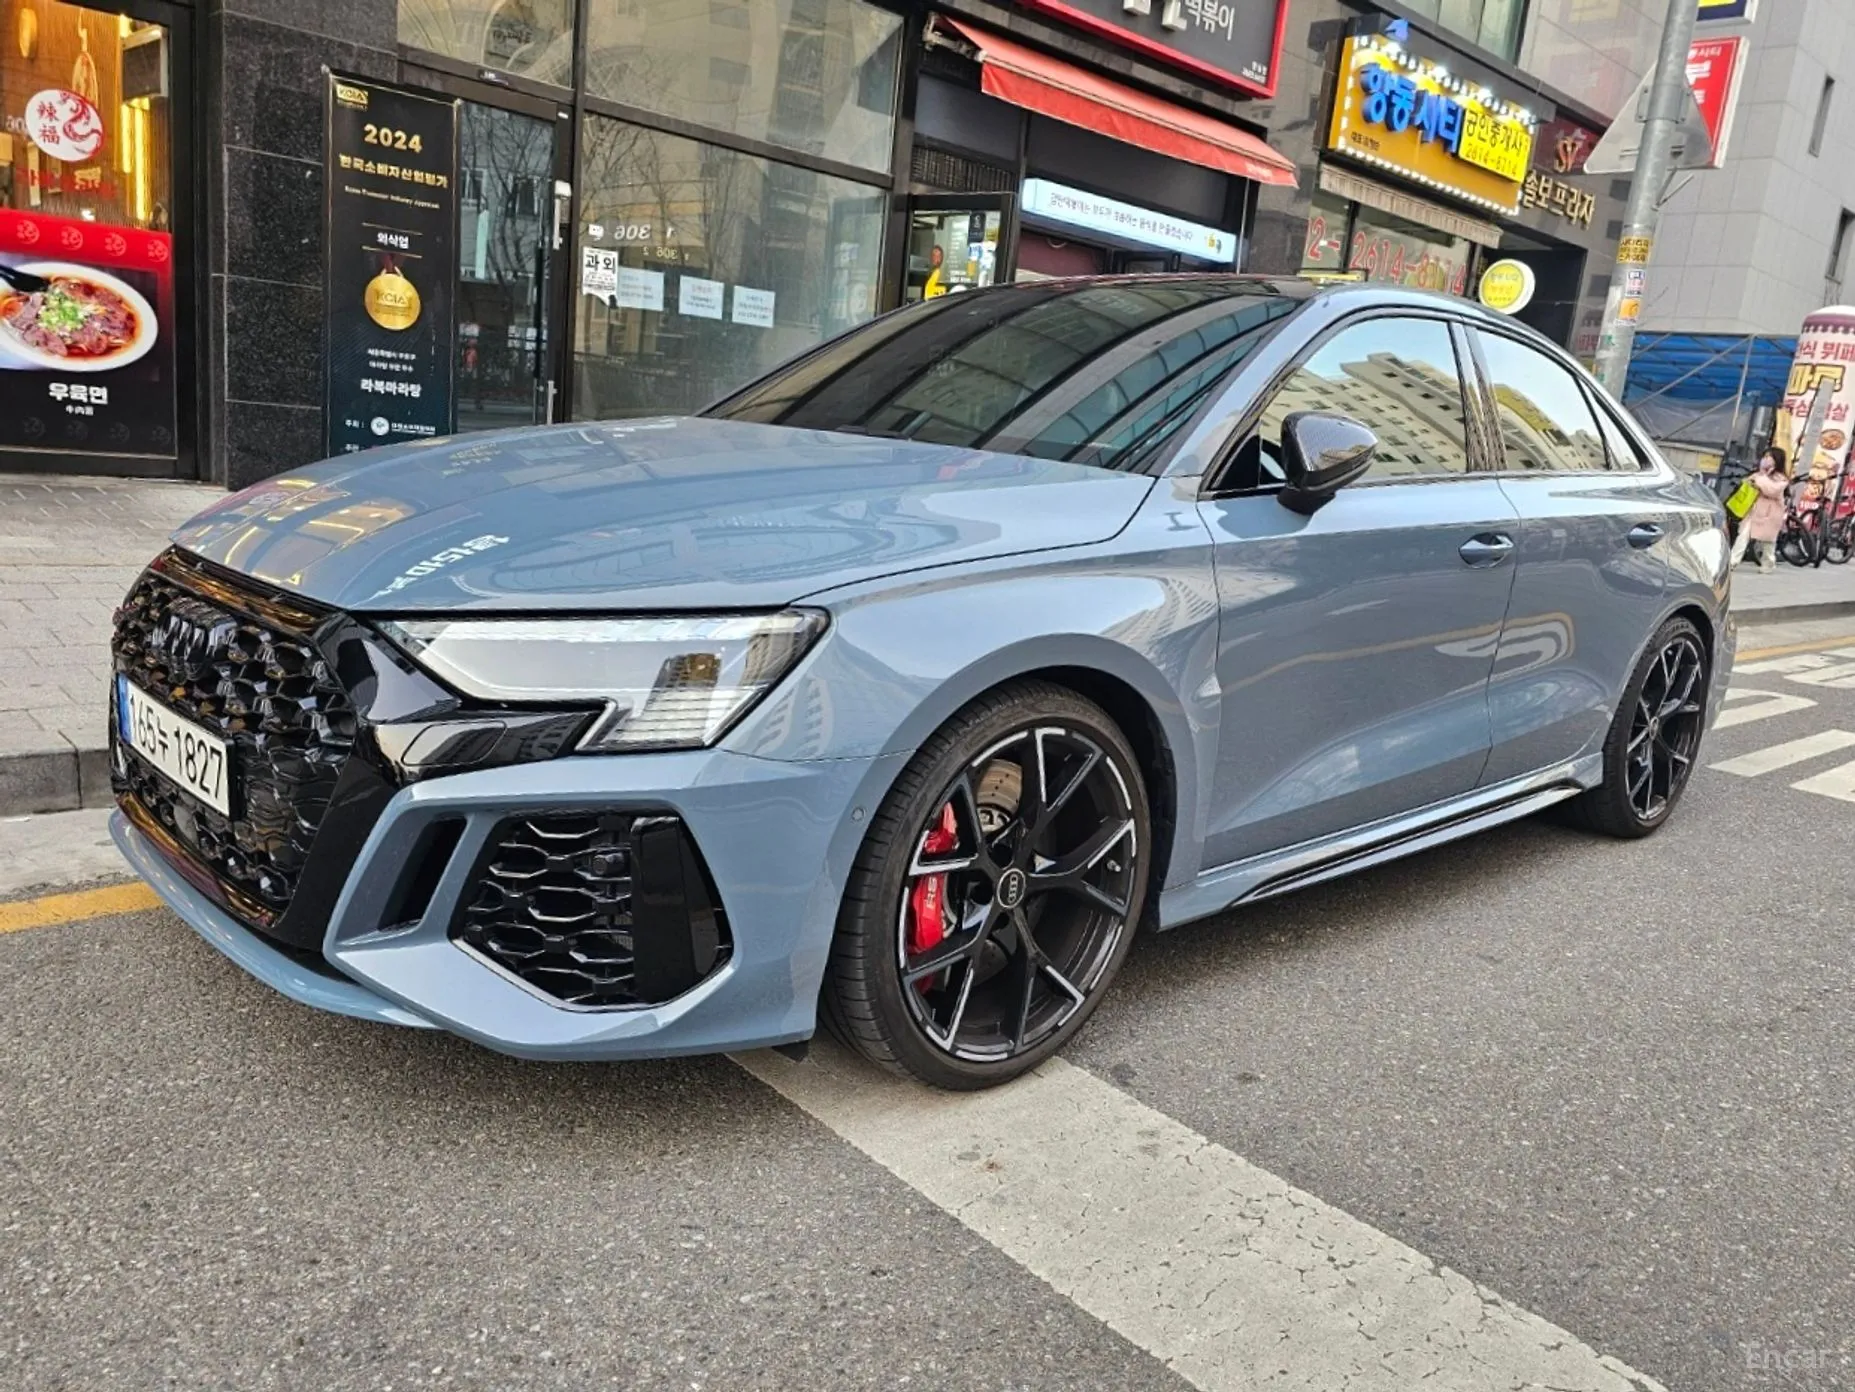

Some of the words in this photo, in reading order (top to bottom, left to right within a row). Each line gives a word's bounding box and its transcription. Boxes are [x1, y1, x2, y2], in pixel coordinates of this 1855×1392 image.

[363, 123, 423, 153] 2024
[1466, 110, 1523, 156] 공인중개사
[1522, 168, 1596, 231] 솔보프라자
[49, 382, 108, 405] 우육면
[130, 693, 169, 763] 165누
[174, 725, 223, 800] 1827
